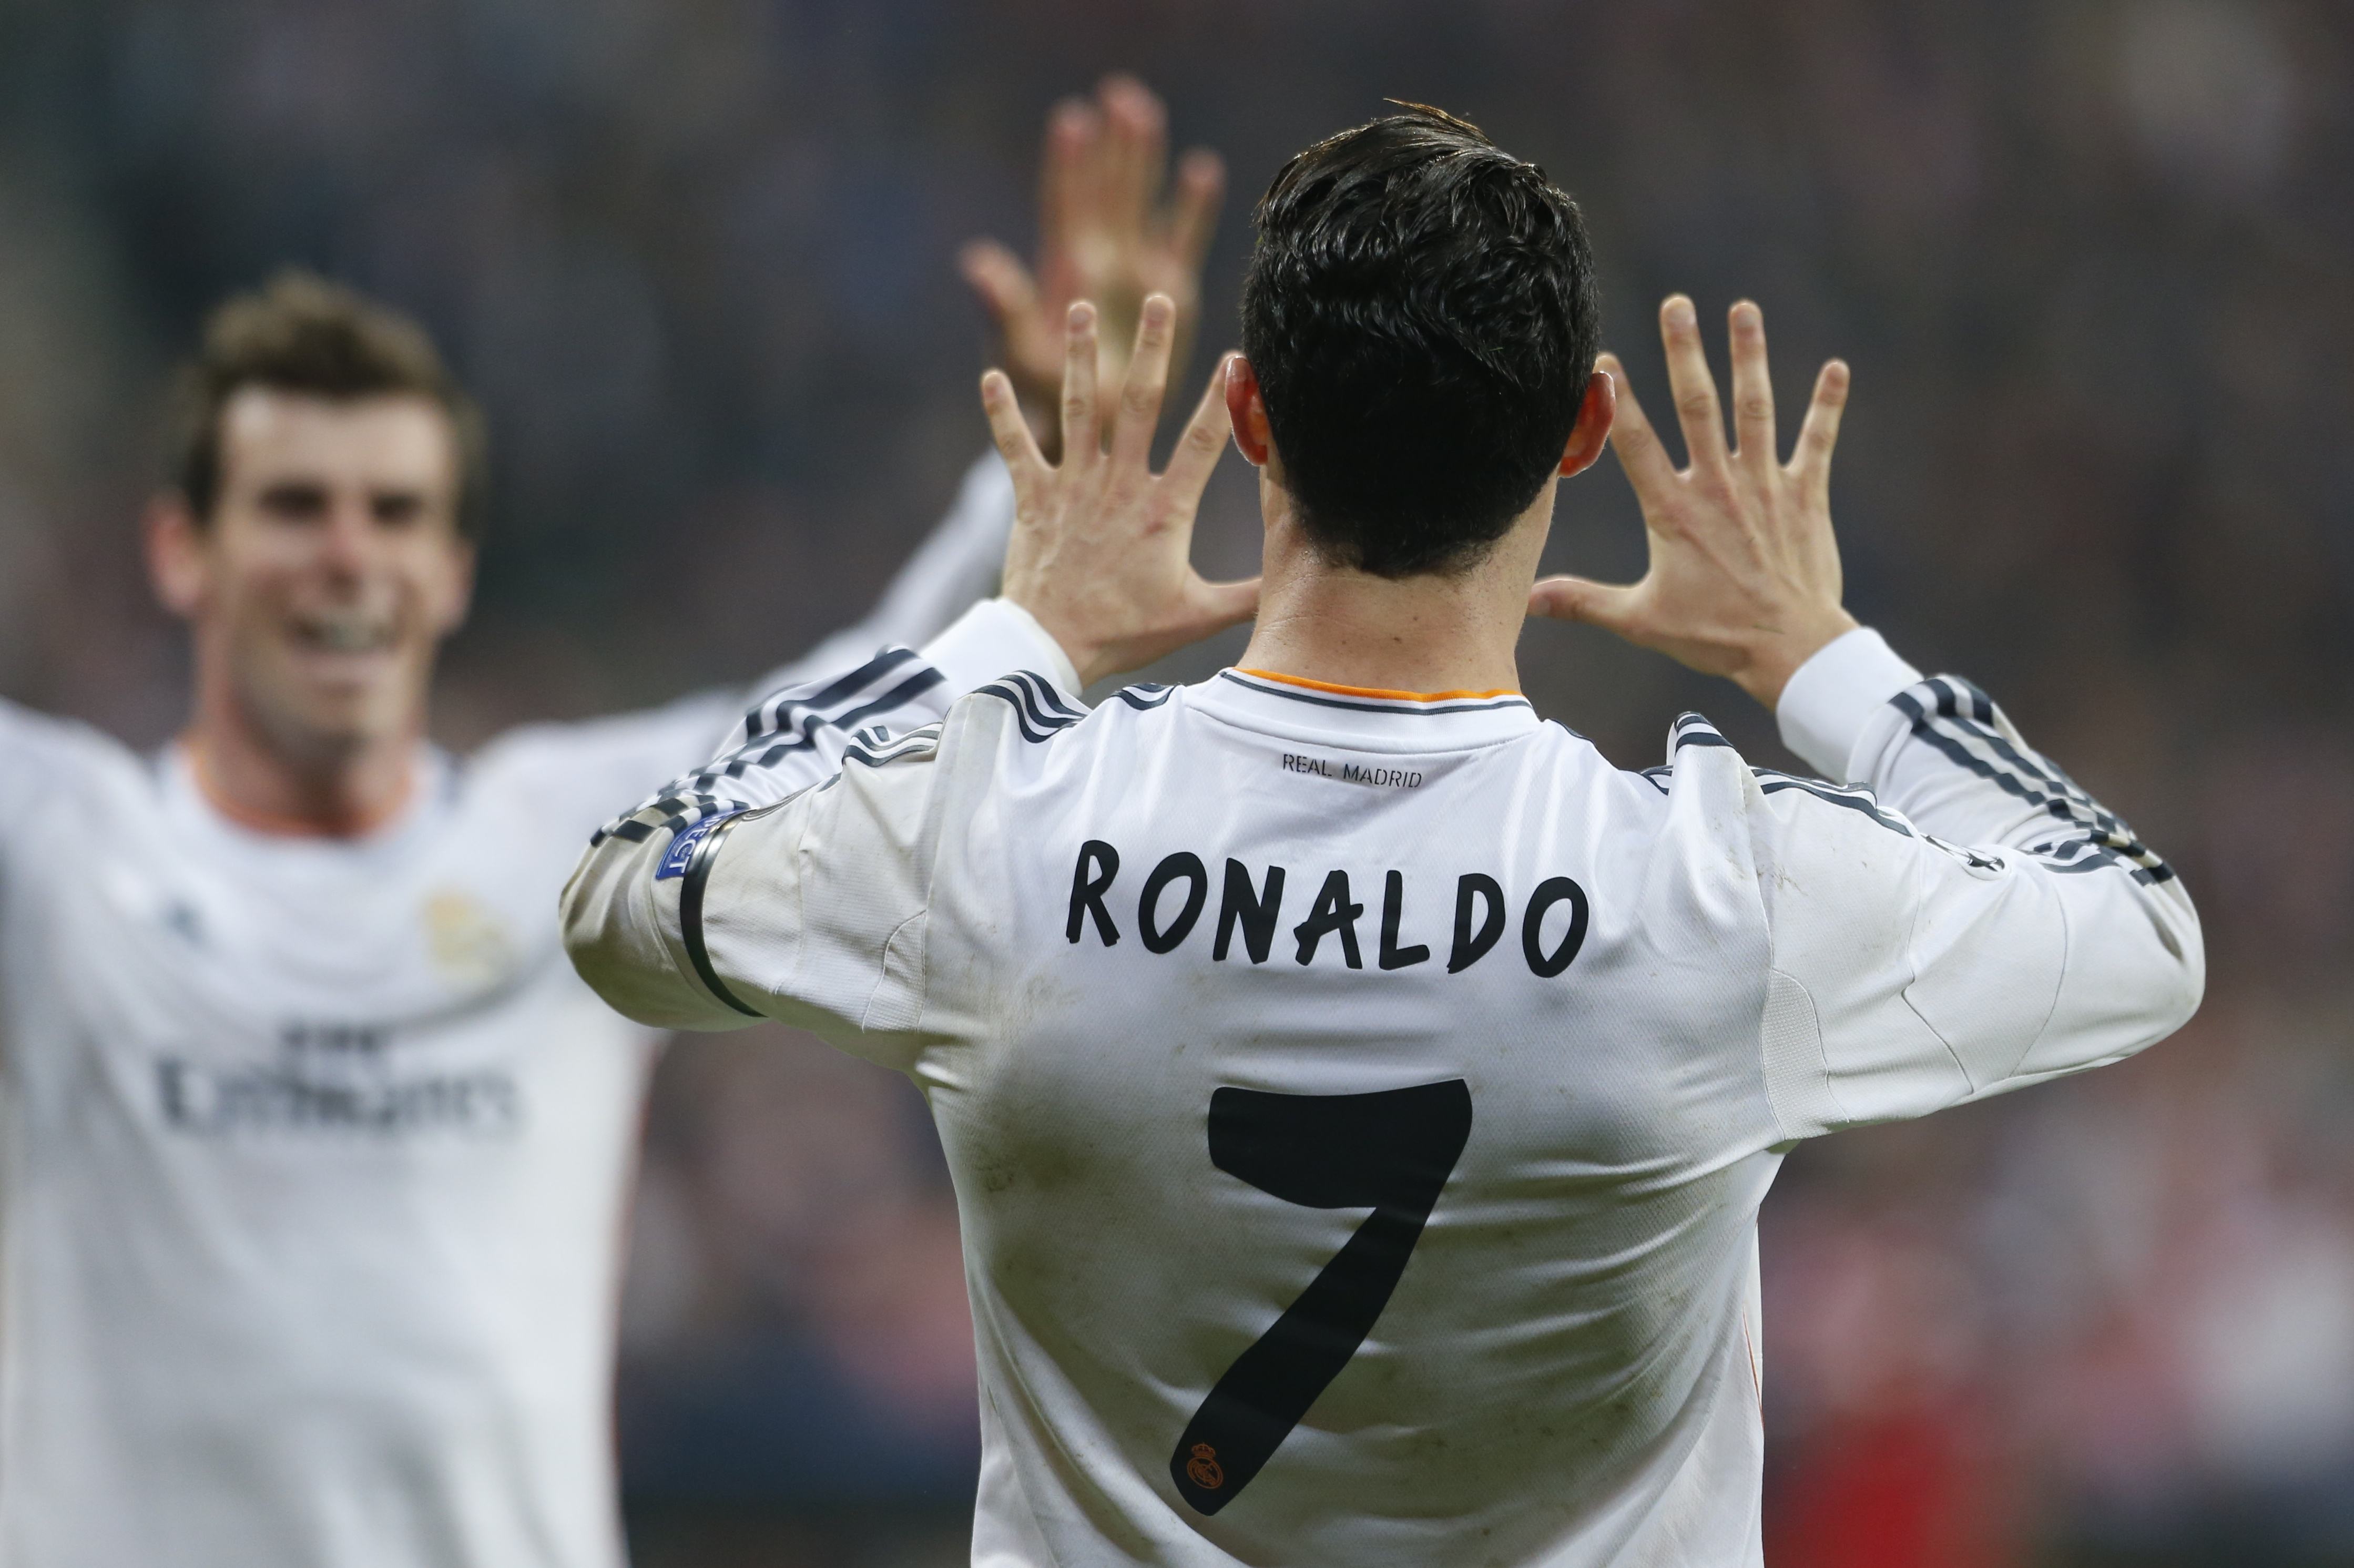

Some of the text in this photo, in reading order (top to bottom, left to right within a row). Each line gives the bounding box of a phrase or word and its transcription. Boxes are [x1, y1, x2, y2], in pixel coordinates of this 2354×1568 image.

[1282, 754, 1422, 788] REAL MADRID
[1066, 840, 1589, 978] RONALDO
[1170, 1078, 1472, 1516] 7
